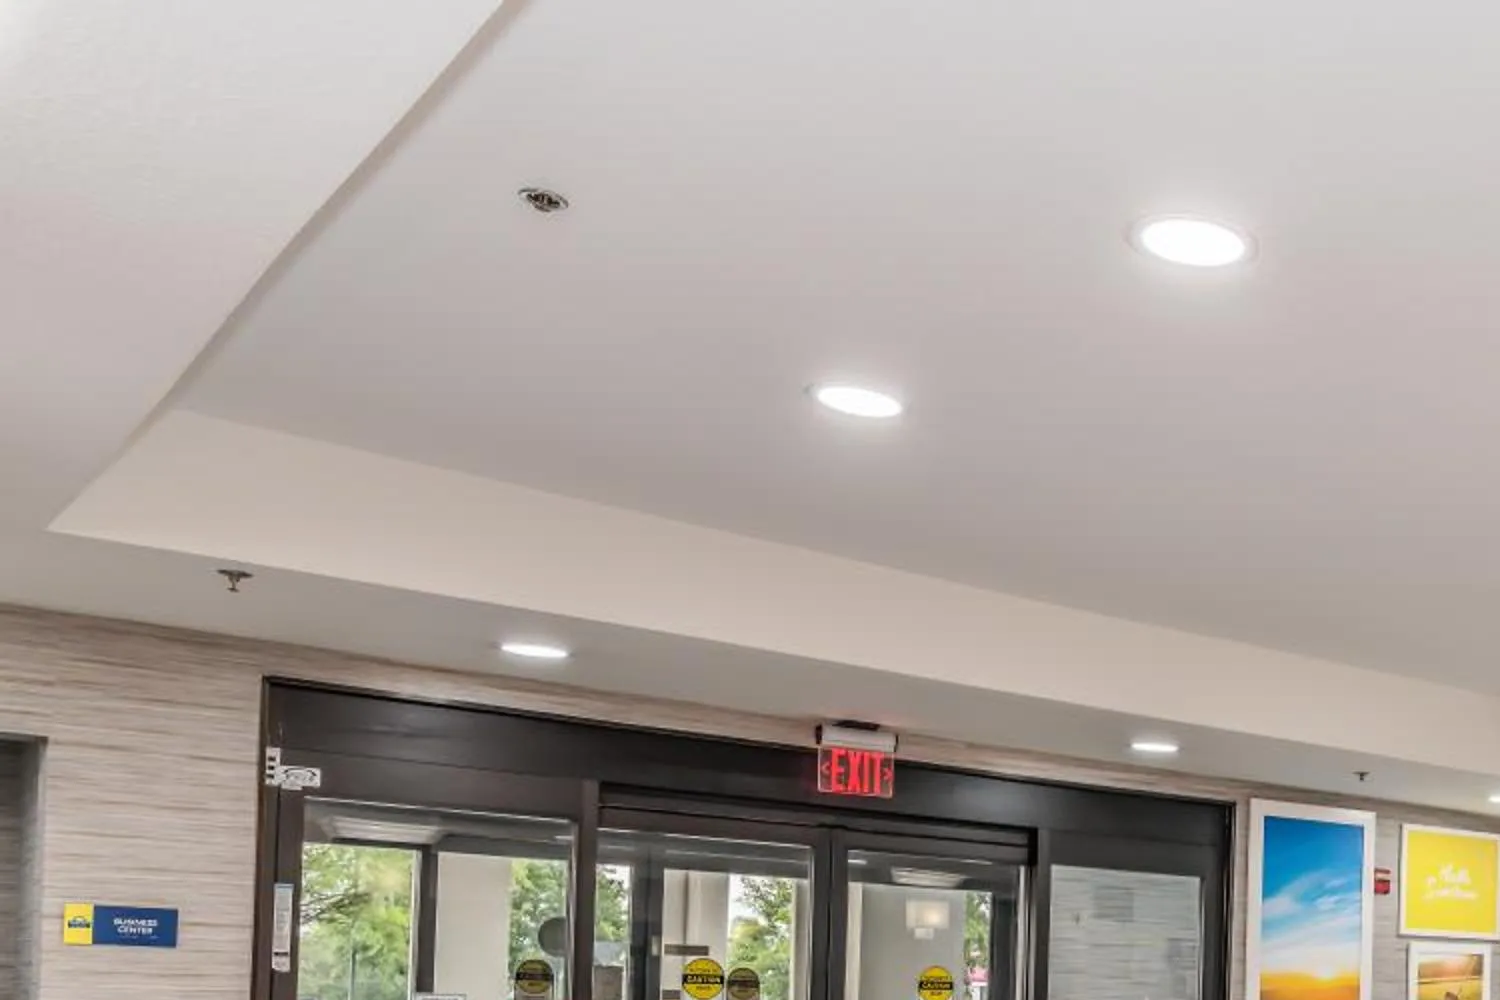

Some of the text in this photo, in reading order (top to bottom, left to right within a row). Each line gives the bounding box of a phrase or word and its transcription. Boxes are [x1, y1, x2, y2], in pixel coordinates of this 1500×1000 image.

[831, 748, 884, 794] EXIT
[113, 917, 158, 927] BUSINESS
[117, 925, 153, 935] CENTER
